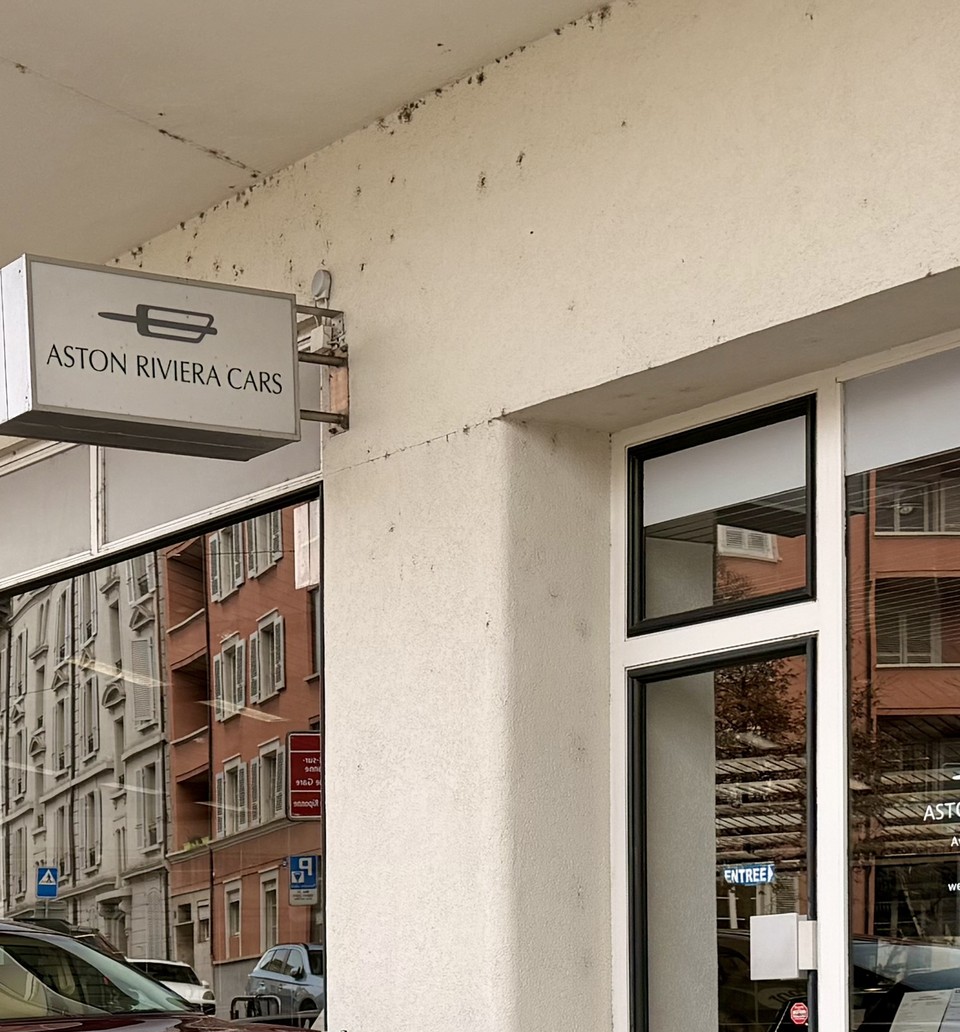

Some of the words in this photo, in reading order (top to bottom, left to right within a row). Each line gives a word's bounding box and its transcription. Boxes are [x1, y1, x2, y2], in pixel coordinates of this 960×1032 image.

[46, 344, 127, 375] ASTON
[136, 355, 221, 387] RIVIERA
[227, 367, 283, 395] CARS
[724, 867, 767, 884] ENTREE
